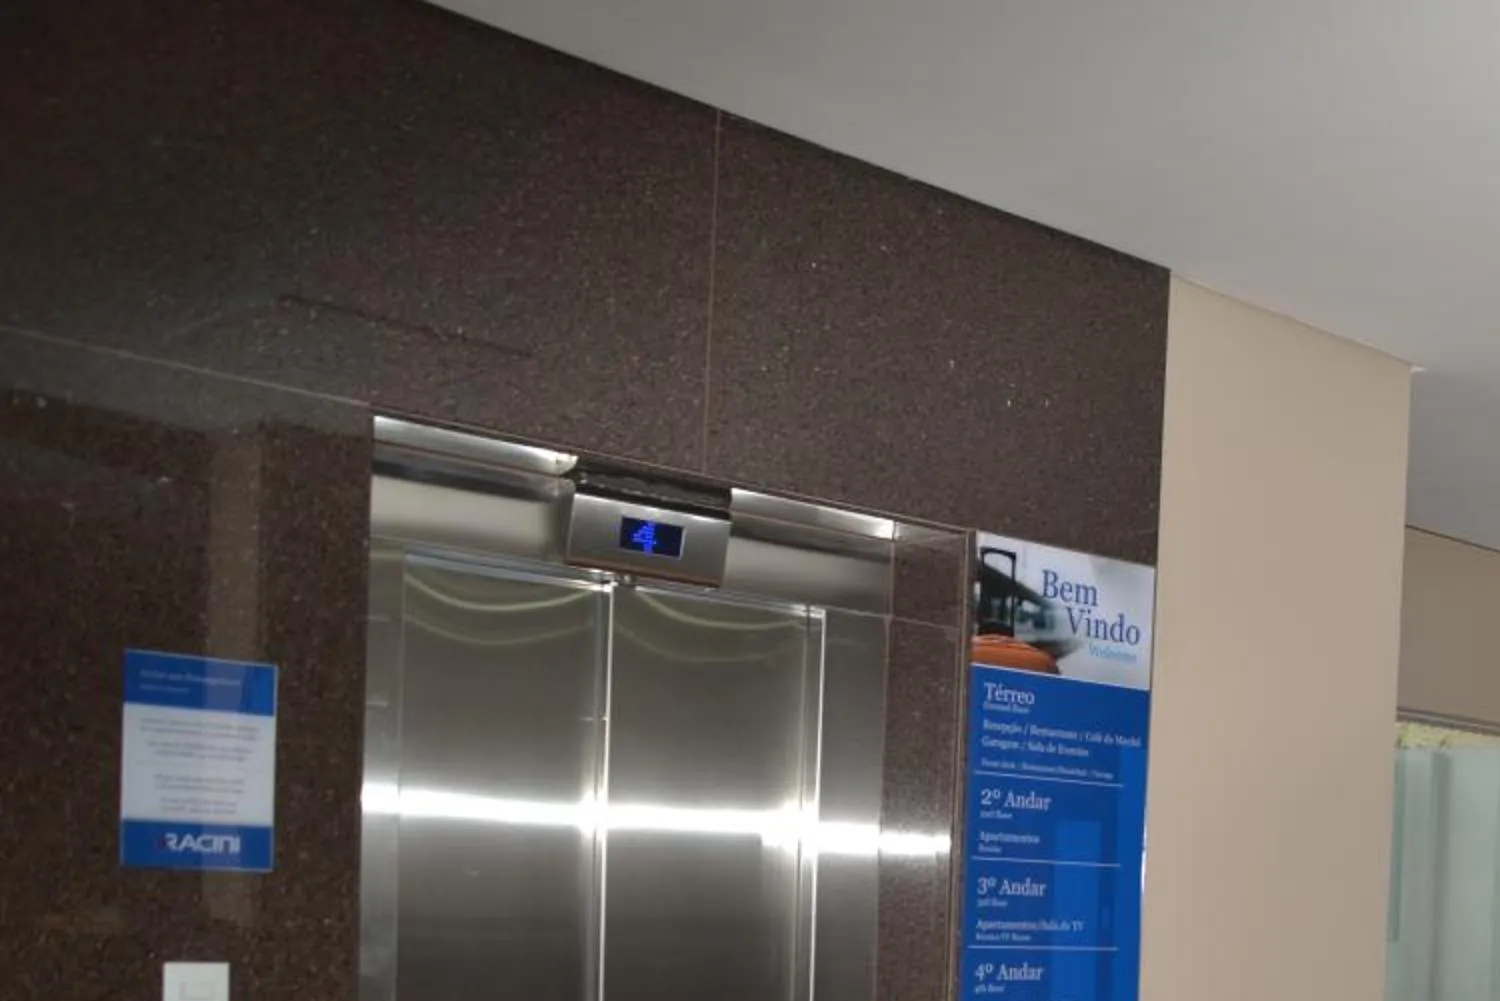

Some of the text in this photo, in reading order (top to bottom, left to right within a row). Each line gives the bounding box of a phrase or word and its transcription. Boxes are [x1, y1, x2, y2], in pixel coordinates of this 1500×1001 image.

[632, 519, 657, 555] 4
[1042, 569, 1098, 607] Bem
[1066, 606, 1141, 645] Vindo
[983, 682, 1035, 704] Térreo
[1004, 790, 1052, 810] Andar
[999, 877, 1048, 896] Andar
[996, 961, 1044, 981] Andar
